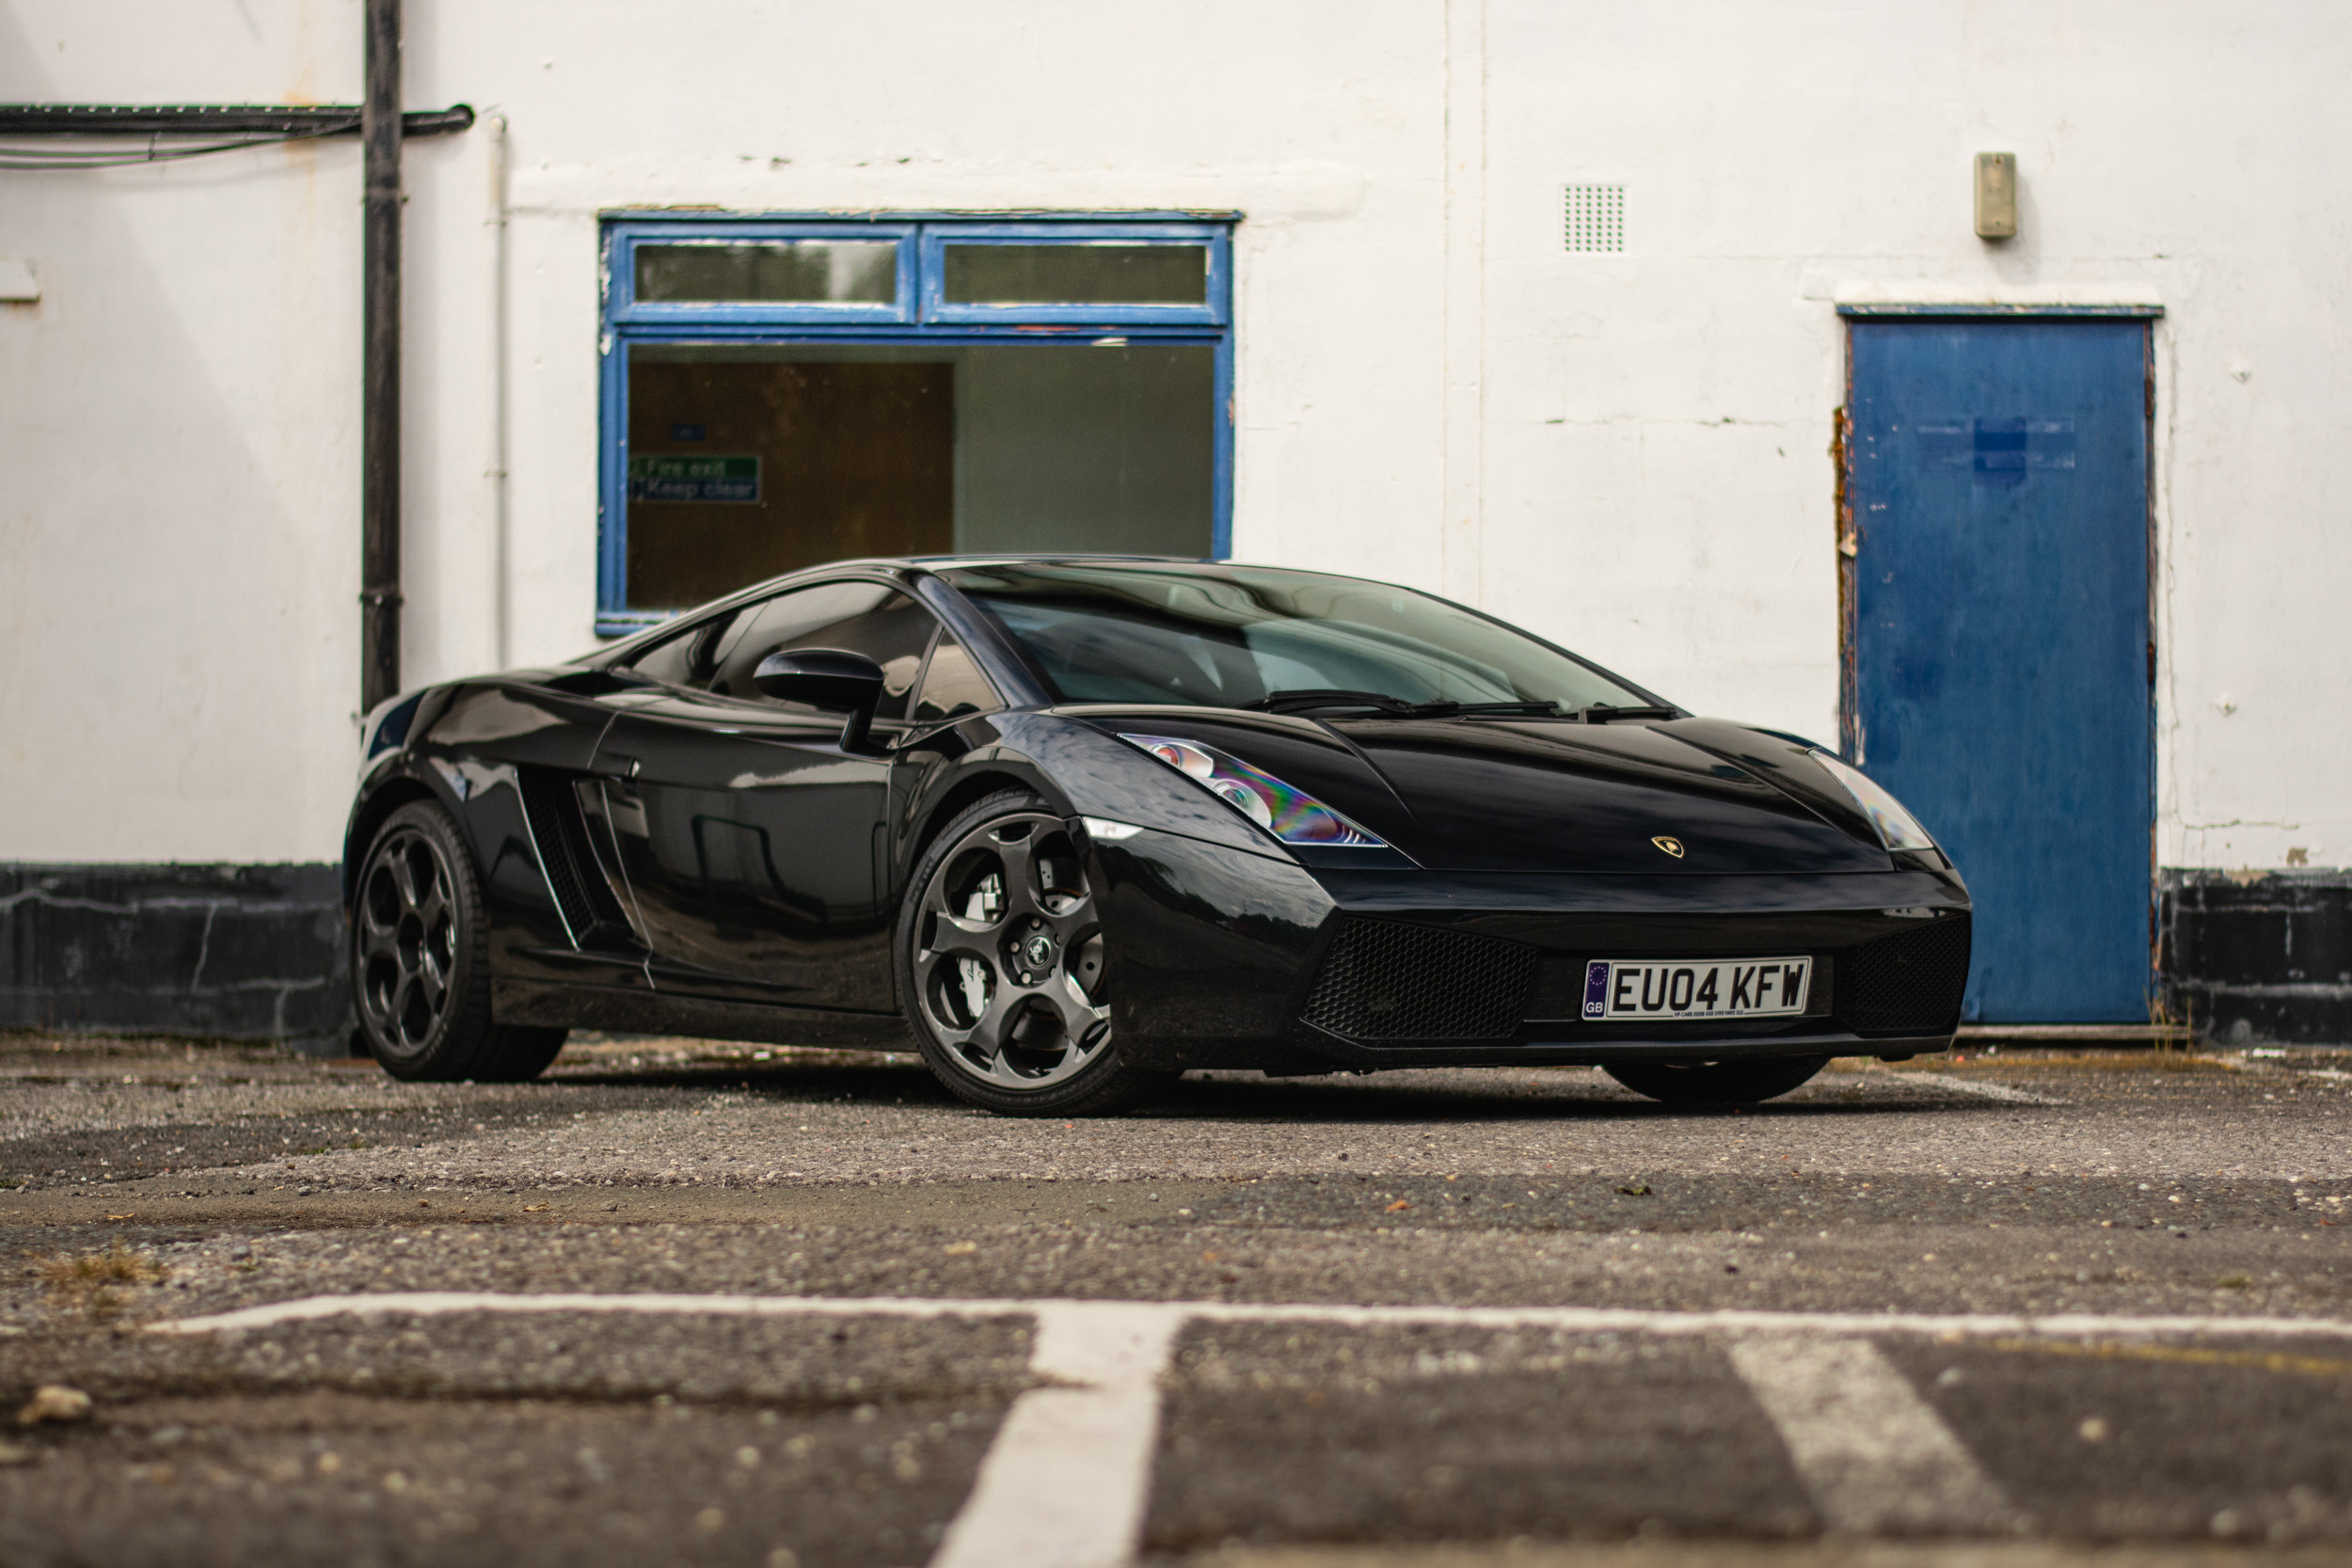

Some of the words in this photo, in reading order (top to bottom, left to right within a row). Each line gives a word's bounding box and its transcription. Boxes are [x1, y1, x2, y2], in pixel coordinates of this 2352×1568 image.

[647, 479, 699, 500] Keep
[704, 478, 754, 498] clear
[1613, 968, 1719, 1011] EU04
[1729, 963, 1804, 1009] KFW
[1585, 1002, 1603, 1013] GB
